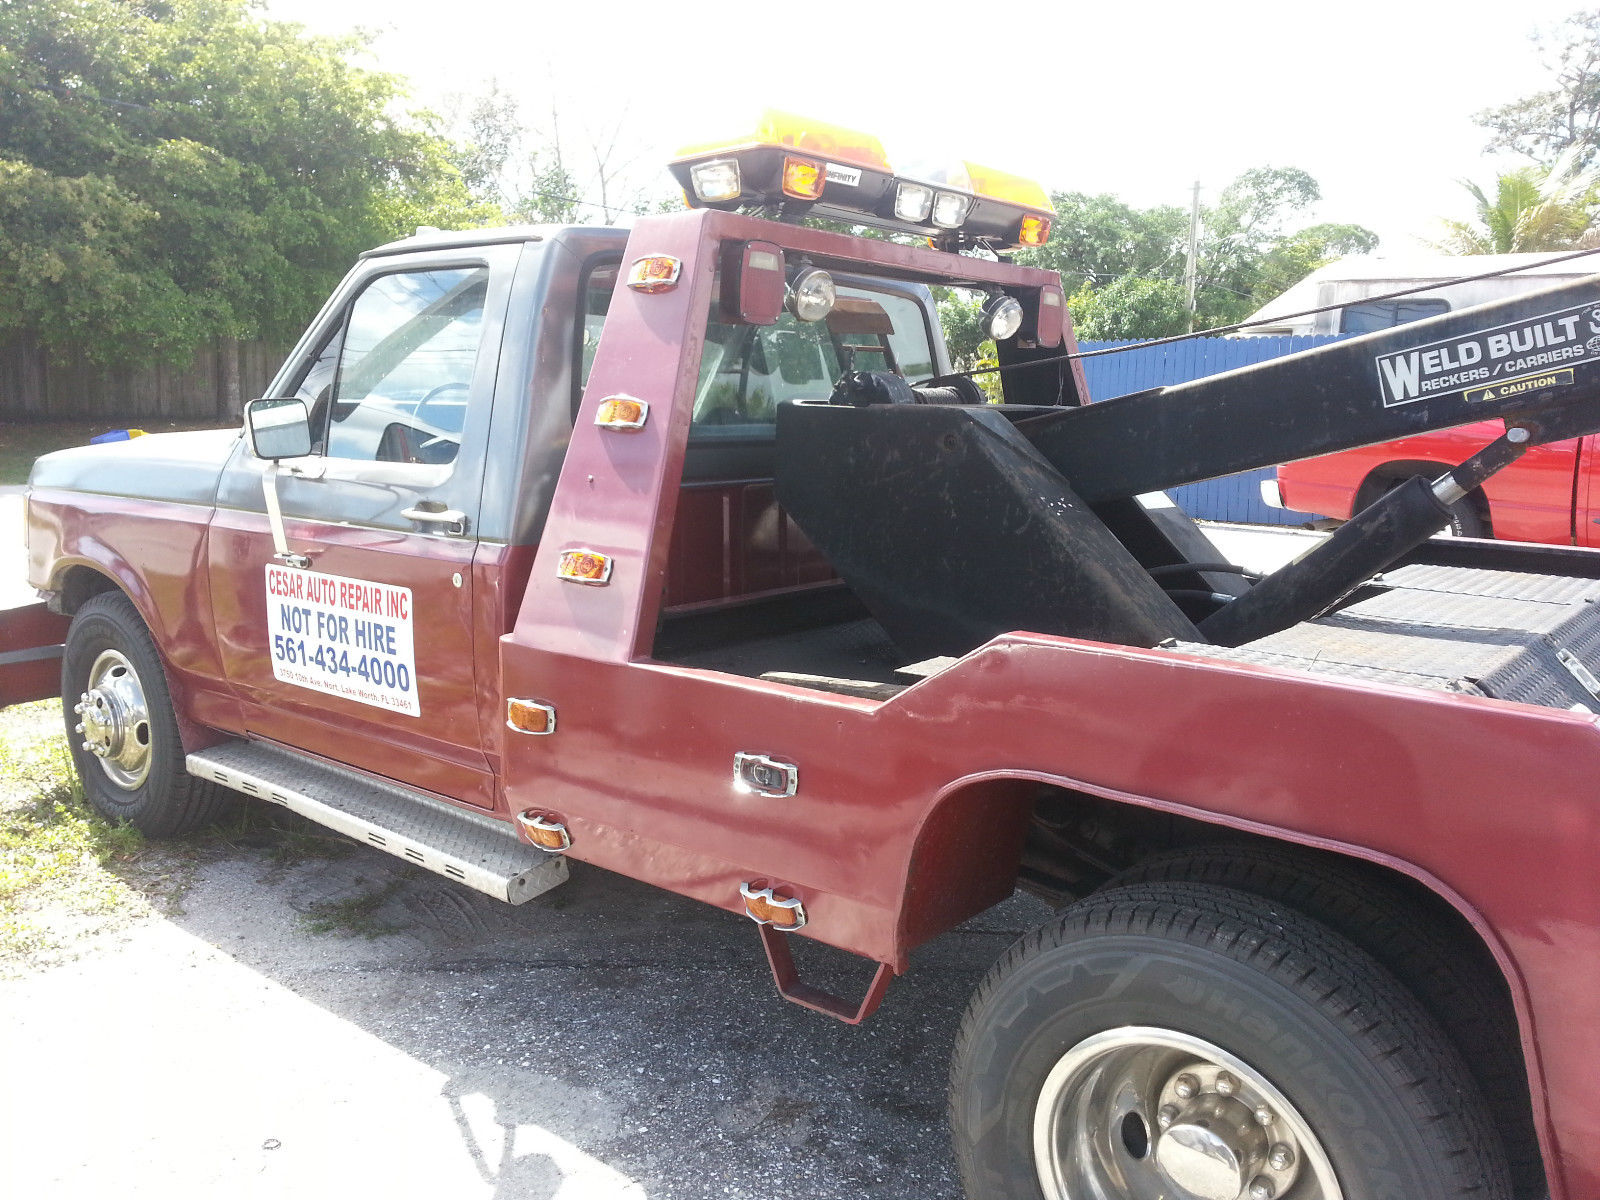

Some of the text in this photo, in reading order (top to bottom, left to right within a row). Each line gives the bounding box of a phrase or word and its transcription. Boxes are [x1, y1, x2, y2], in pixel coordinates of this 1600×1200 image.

[1380, 314, 1580, 401] WELD BUILT
[1504, 344, 1585, 373] CARRIERS
[1500, 375, 1557, 396] CAUTION
[269, 569, 408, 620] CESAR AUTO REPAIR INC
[280, 603, 397, 656] NOT FOR HIRE
[274, 634, 410, 692] 561-434-4000
